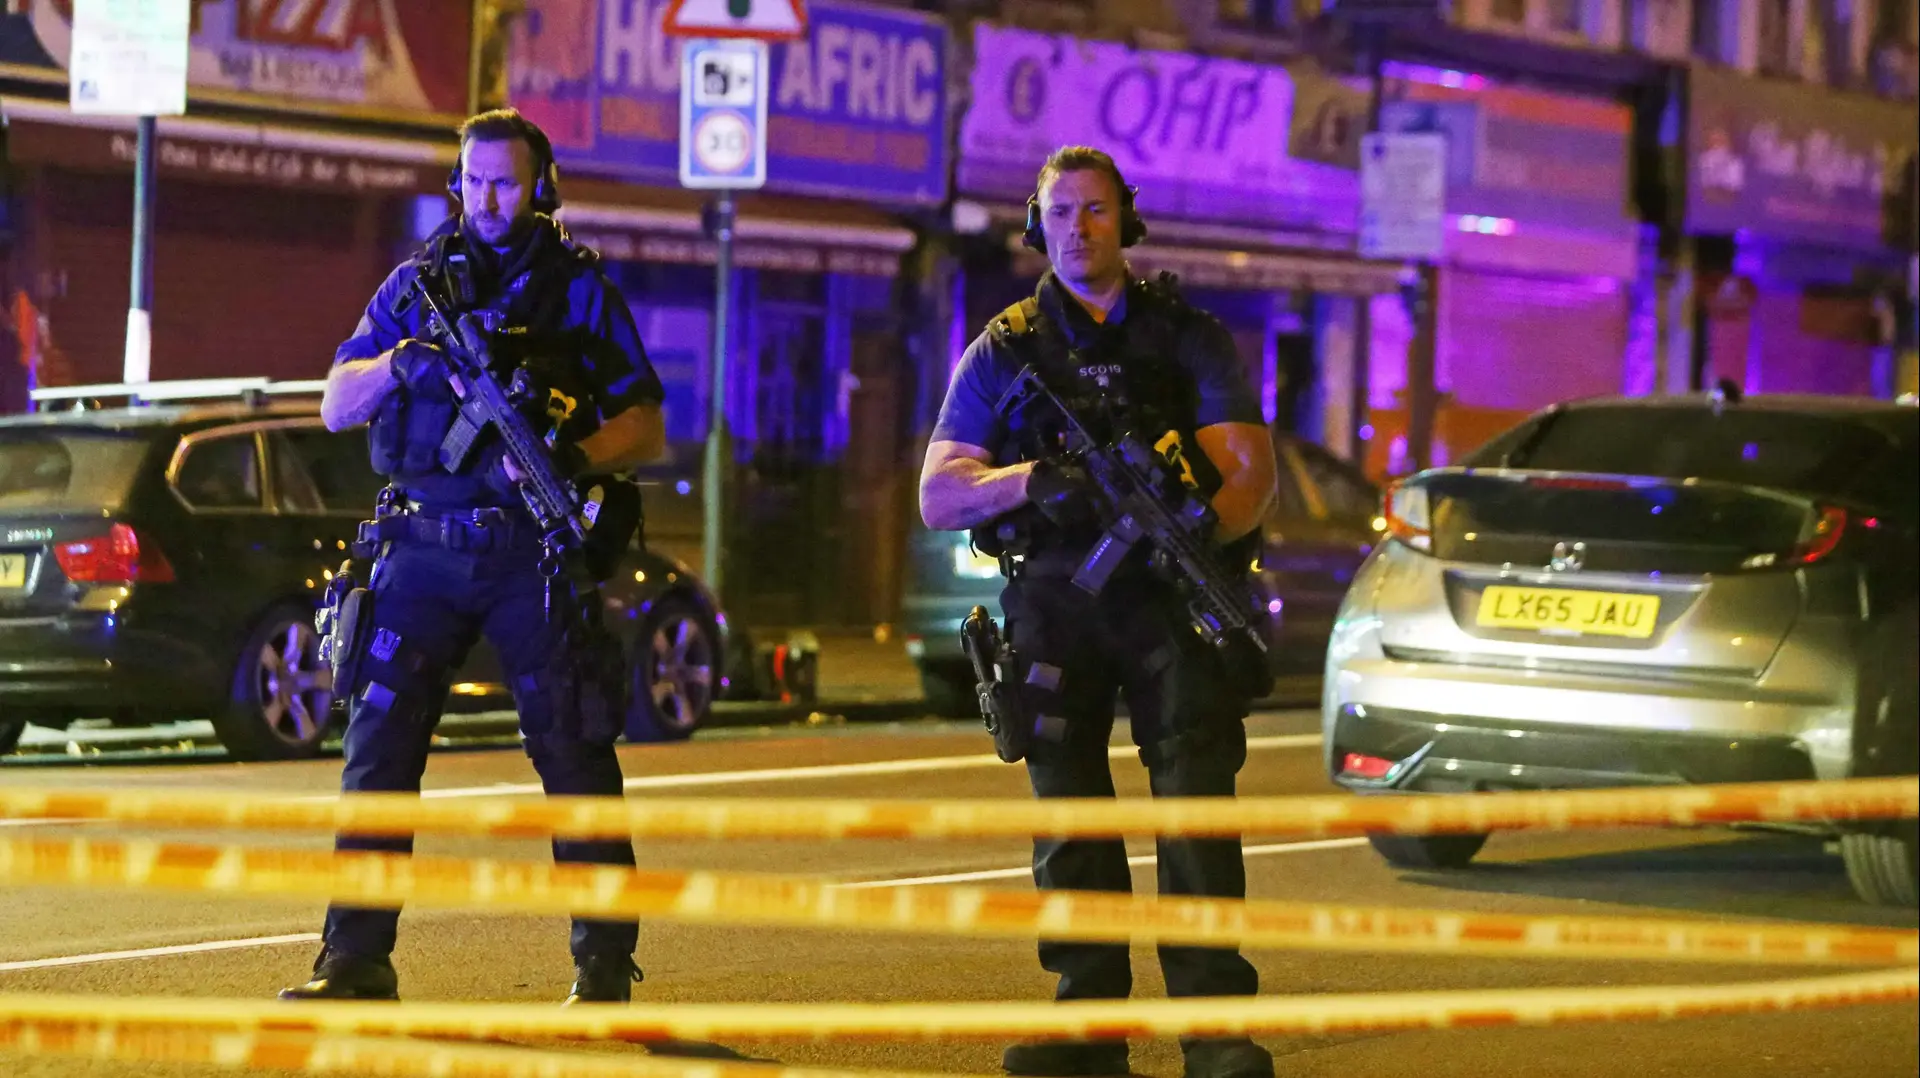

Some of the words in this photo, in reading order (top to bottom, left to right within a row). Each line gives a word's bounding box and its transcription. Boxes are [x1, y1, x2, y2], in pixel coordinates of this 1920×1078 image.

[1079, 364, 1121, 377] SCO19
[1493, 593, 1574, 623] LX65
[1581, 599, 1643, 627] JAU
